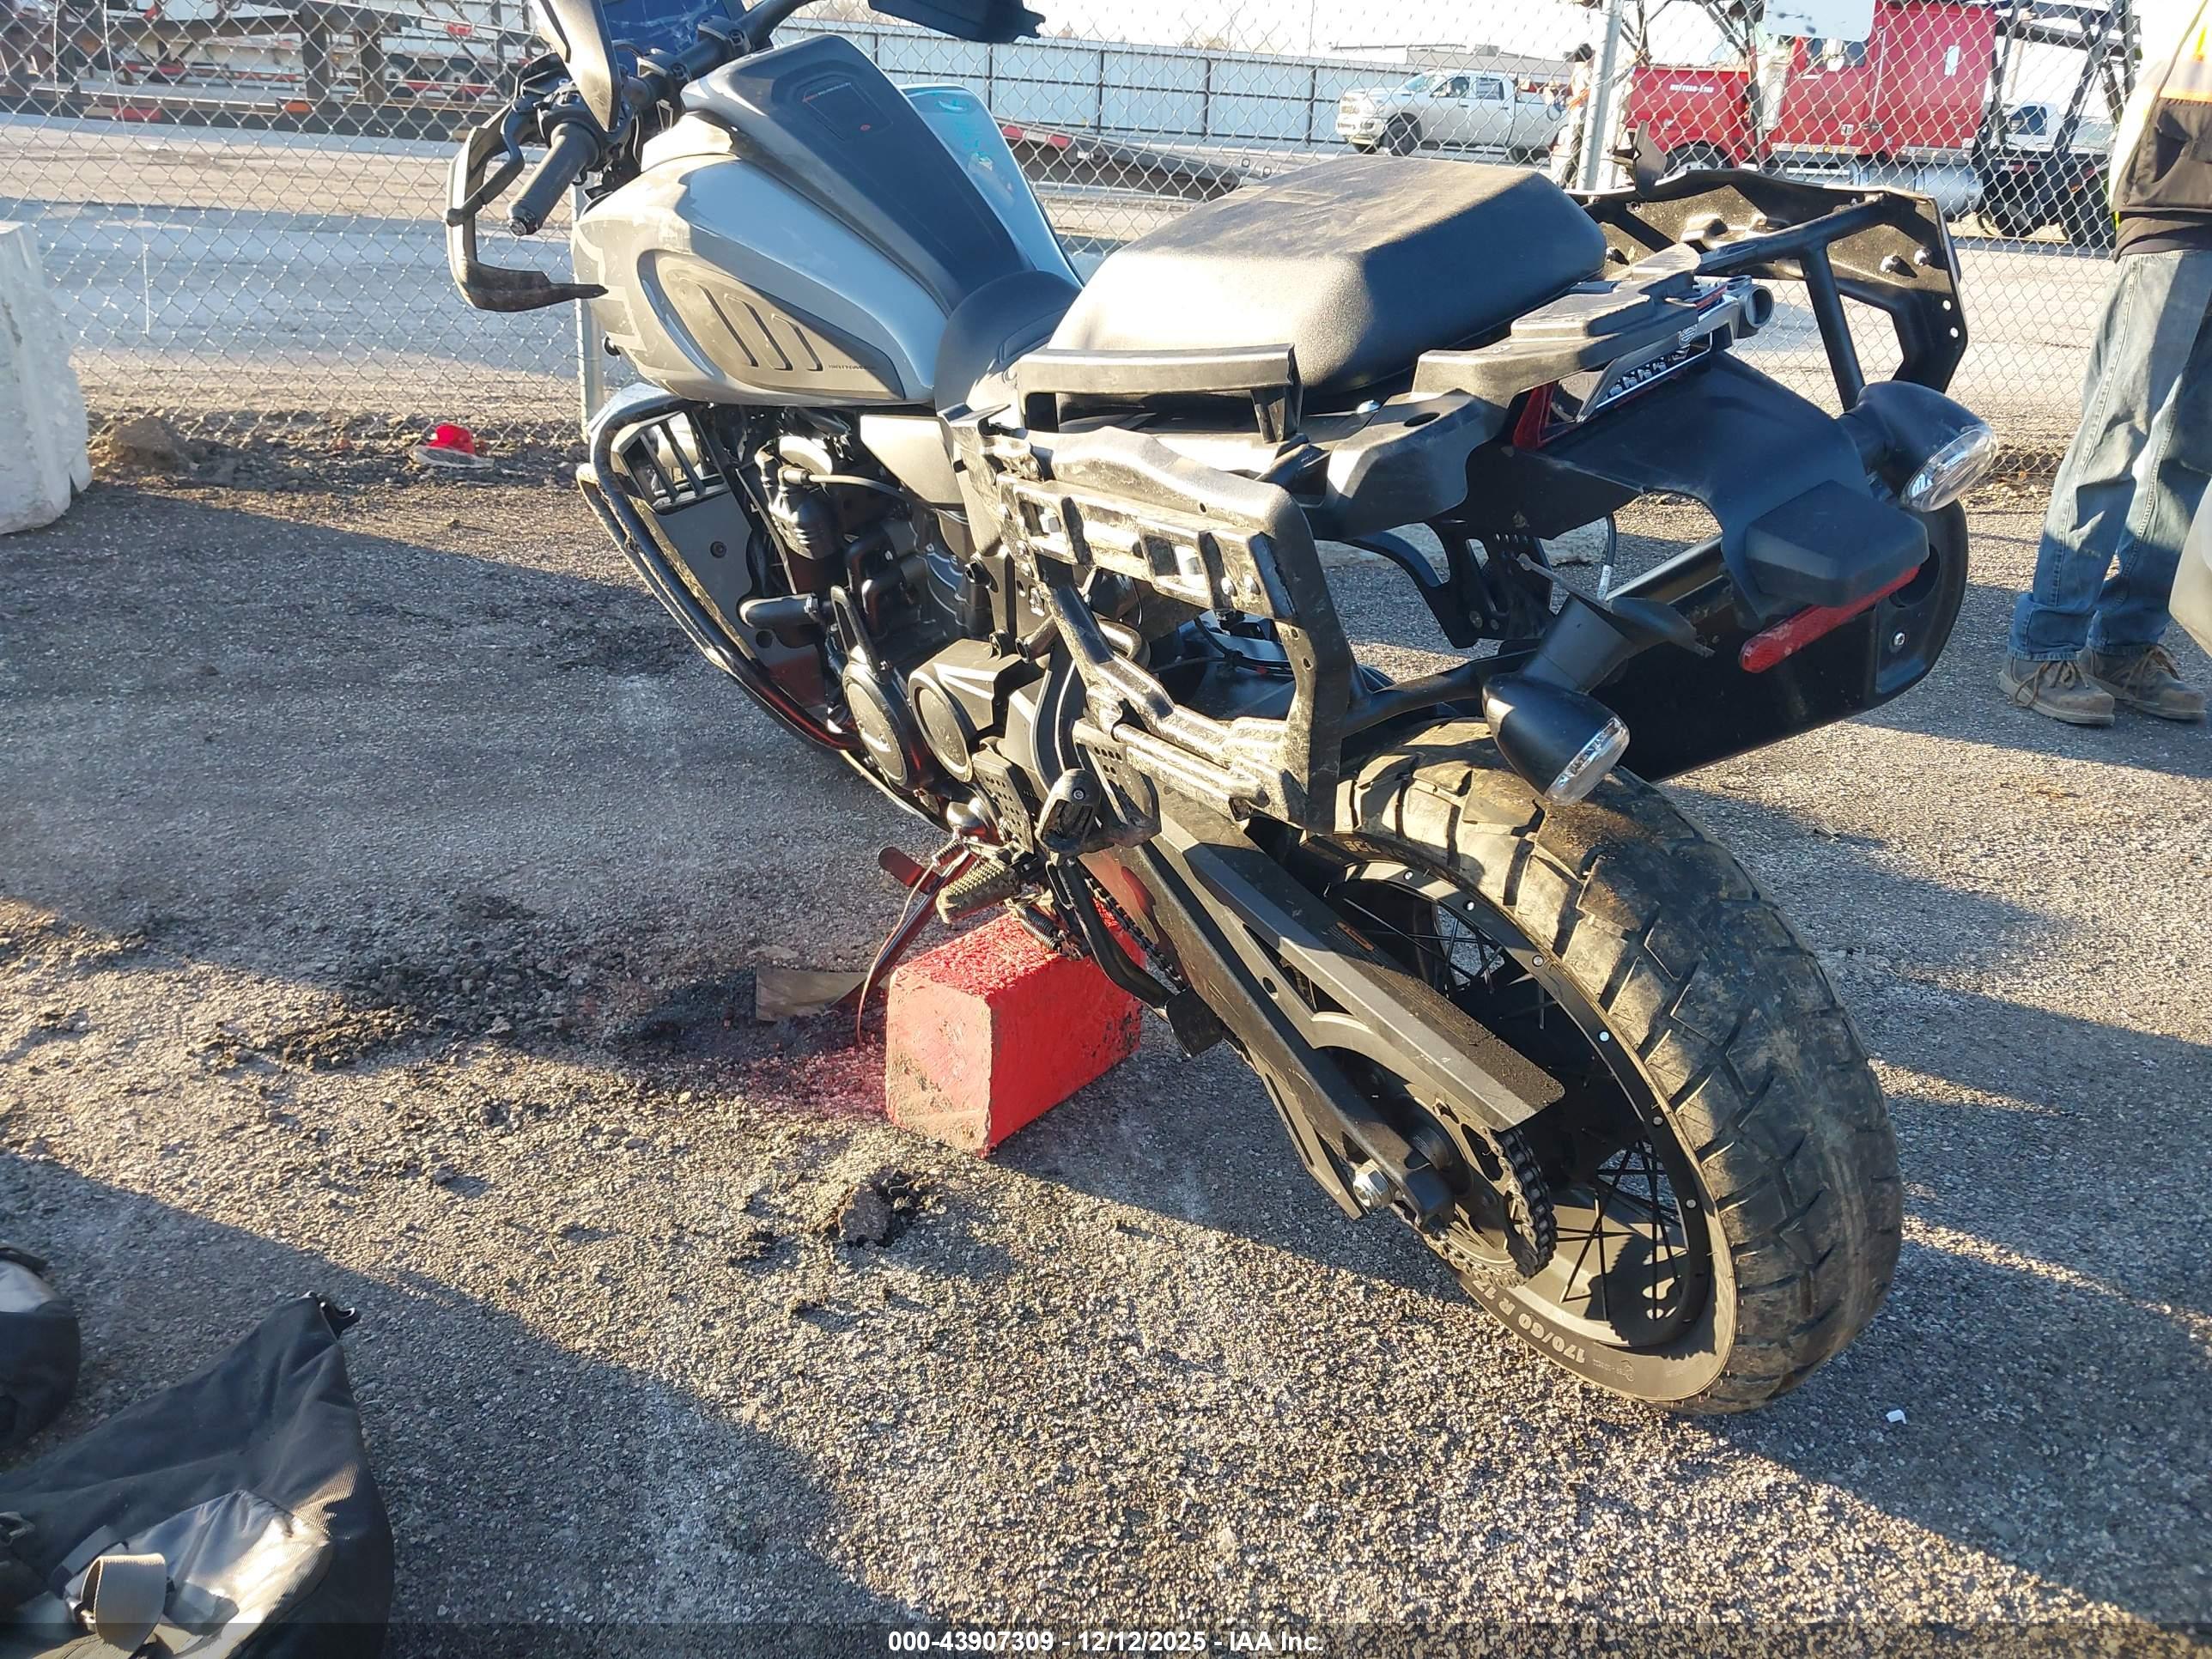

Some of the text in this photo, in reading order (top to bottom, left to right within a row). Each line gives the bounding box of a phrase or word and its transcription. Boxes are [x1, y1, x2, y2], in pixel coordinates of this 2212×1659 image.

[1473, 1279, 1586, 1364] 170/60 R 17
